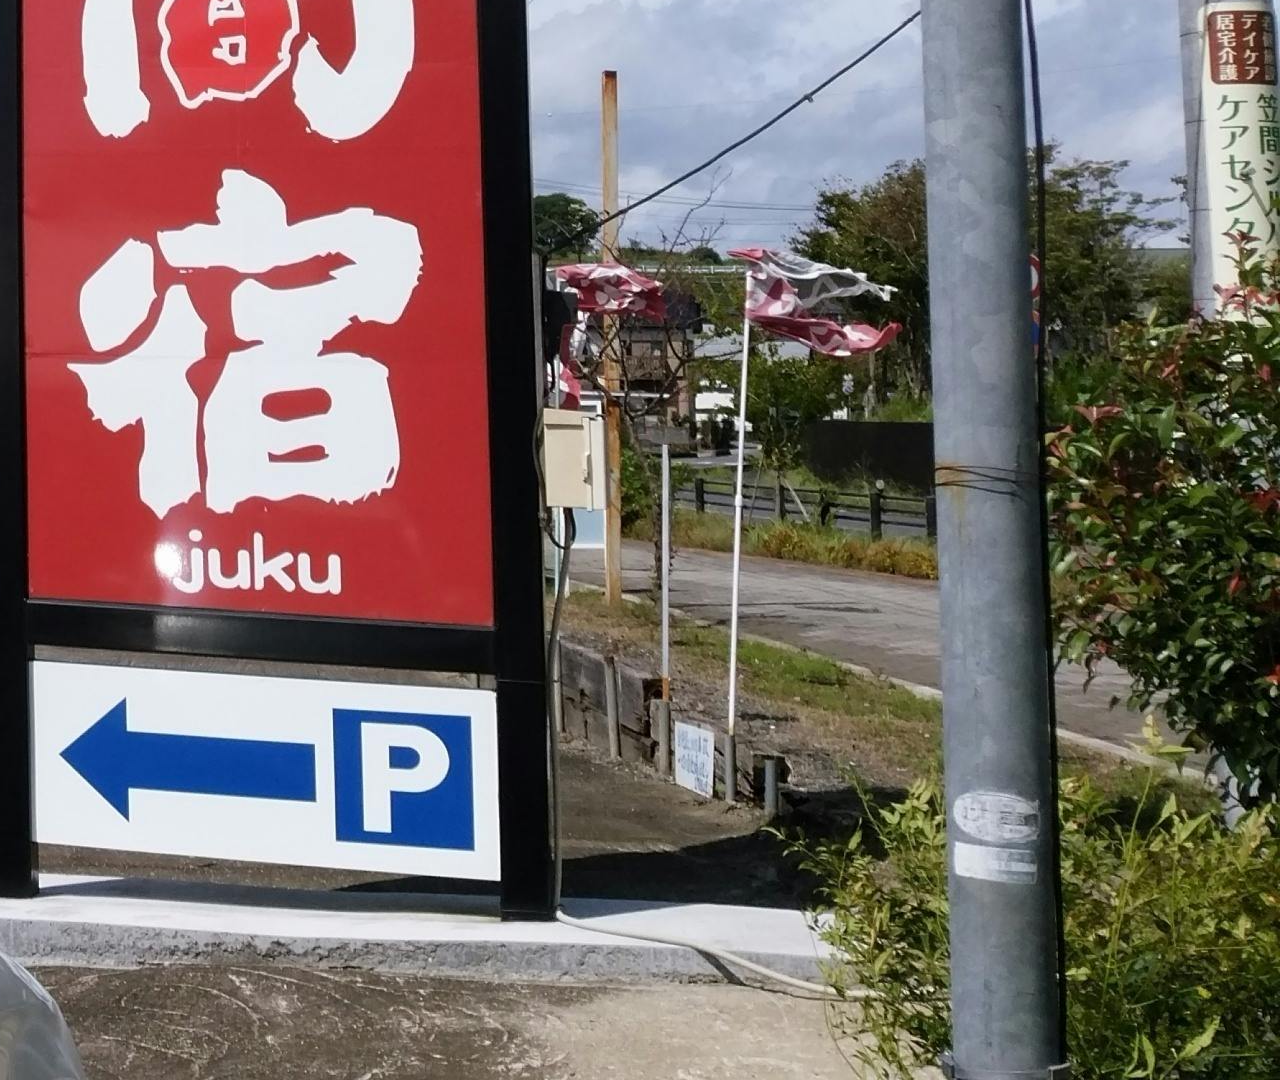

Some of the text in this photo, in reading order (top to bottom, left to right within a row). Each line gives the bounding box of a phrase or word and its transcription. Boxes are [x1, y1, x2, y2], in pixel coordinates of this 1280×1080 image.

[1216, 14, 1239, 81] 居宅介護
[1241, 14, 1260, 80] デイケア
[173, 529, 342, 596] juku
[361, 722, 451, 834] P
